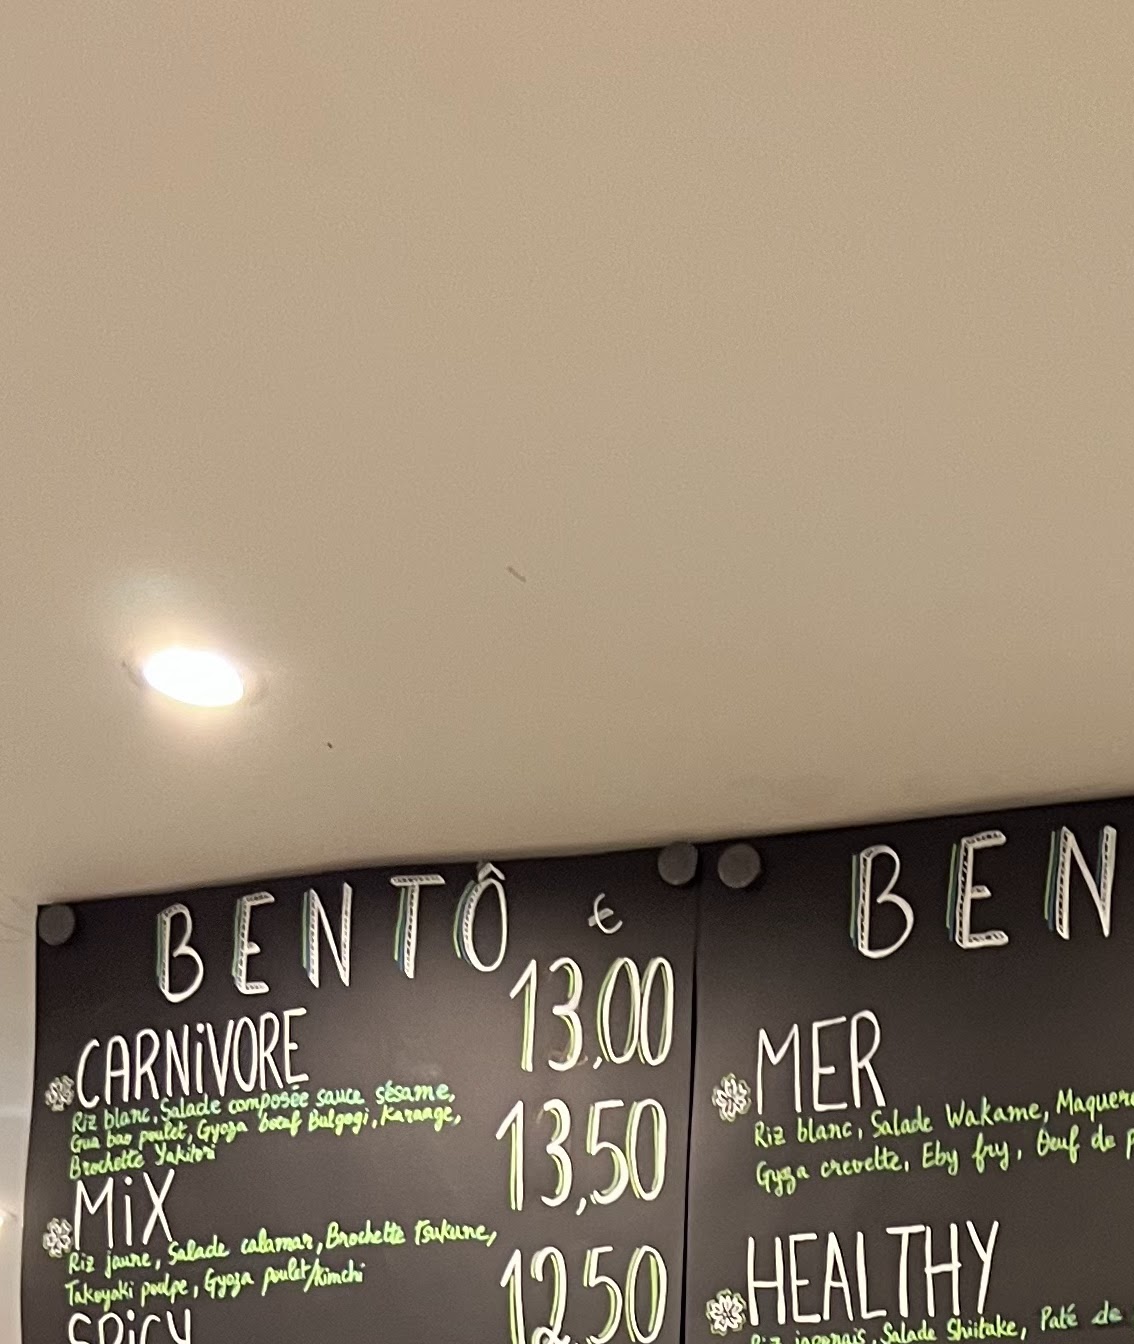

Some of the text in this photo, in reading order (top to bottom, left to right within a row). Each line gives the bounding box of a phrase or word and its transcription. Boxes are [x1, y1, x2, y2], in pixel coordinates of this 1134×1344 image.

[155, 862, 623, 1003] BENTÔ €
[509, 956, 675, 1072] 13,00
[755, 1009, 887, 1116] MER
[72, 1111, 100, 1132] Riz
[161, 1097, 221, 1122] Salade
[496, 1099, 668, 1215] 13,50
[754, 1121, 786, 1148] Riz
[871, 1105, 933, 1138] Salade
[922, 1142, 959, 1176] Eby
[1091, 1124, 1115, 1152] de
[69, 1253, 95, 1273] Riz
[168, 1236, 230, 1265] Salade
[745, 1220, 999, 1326] HEALTHY
